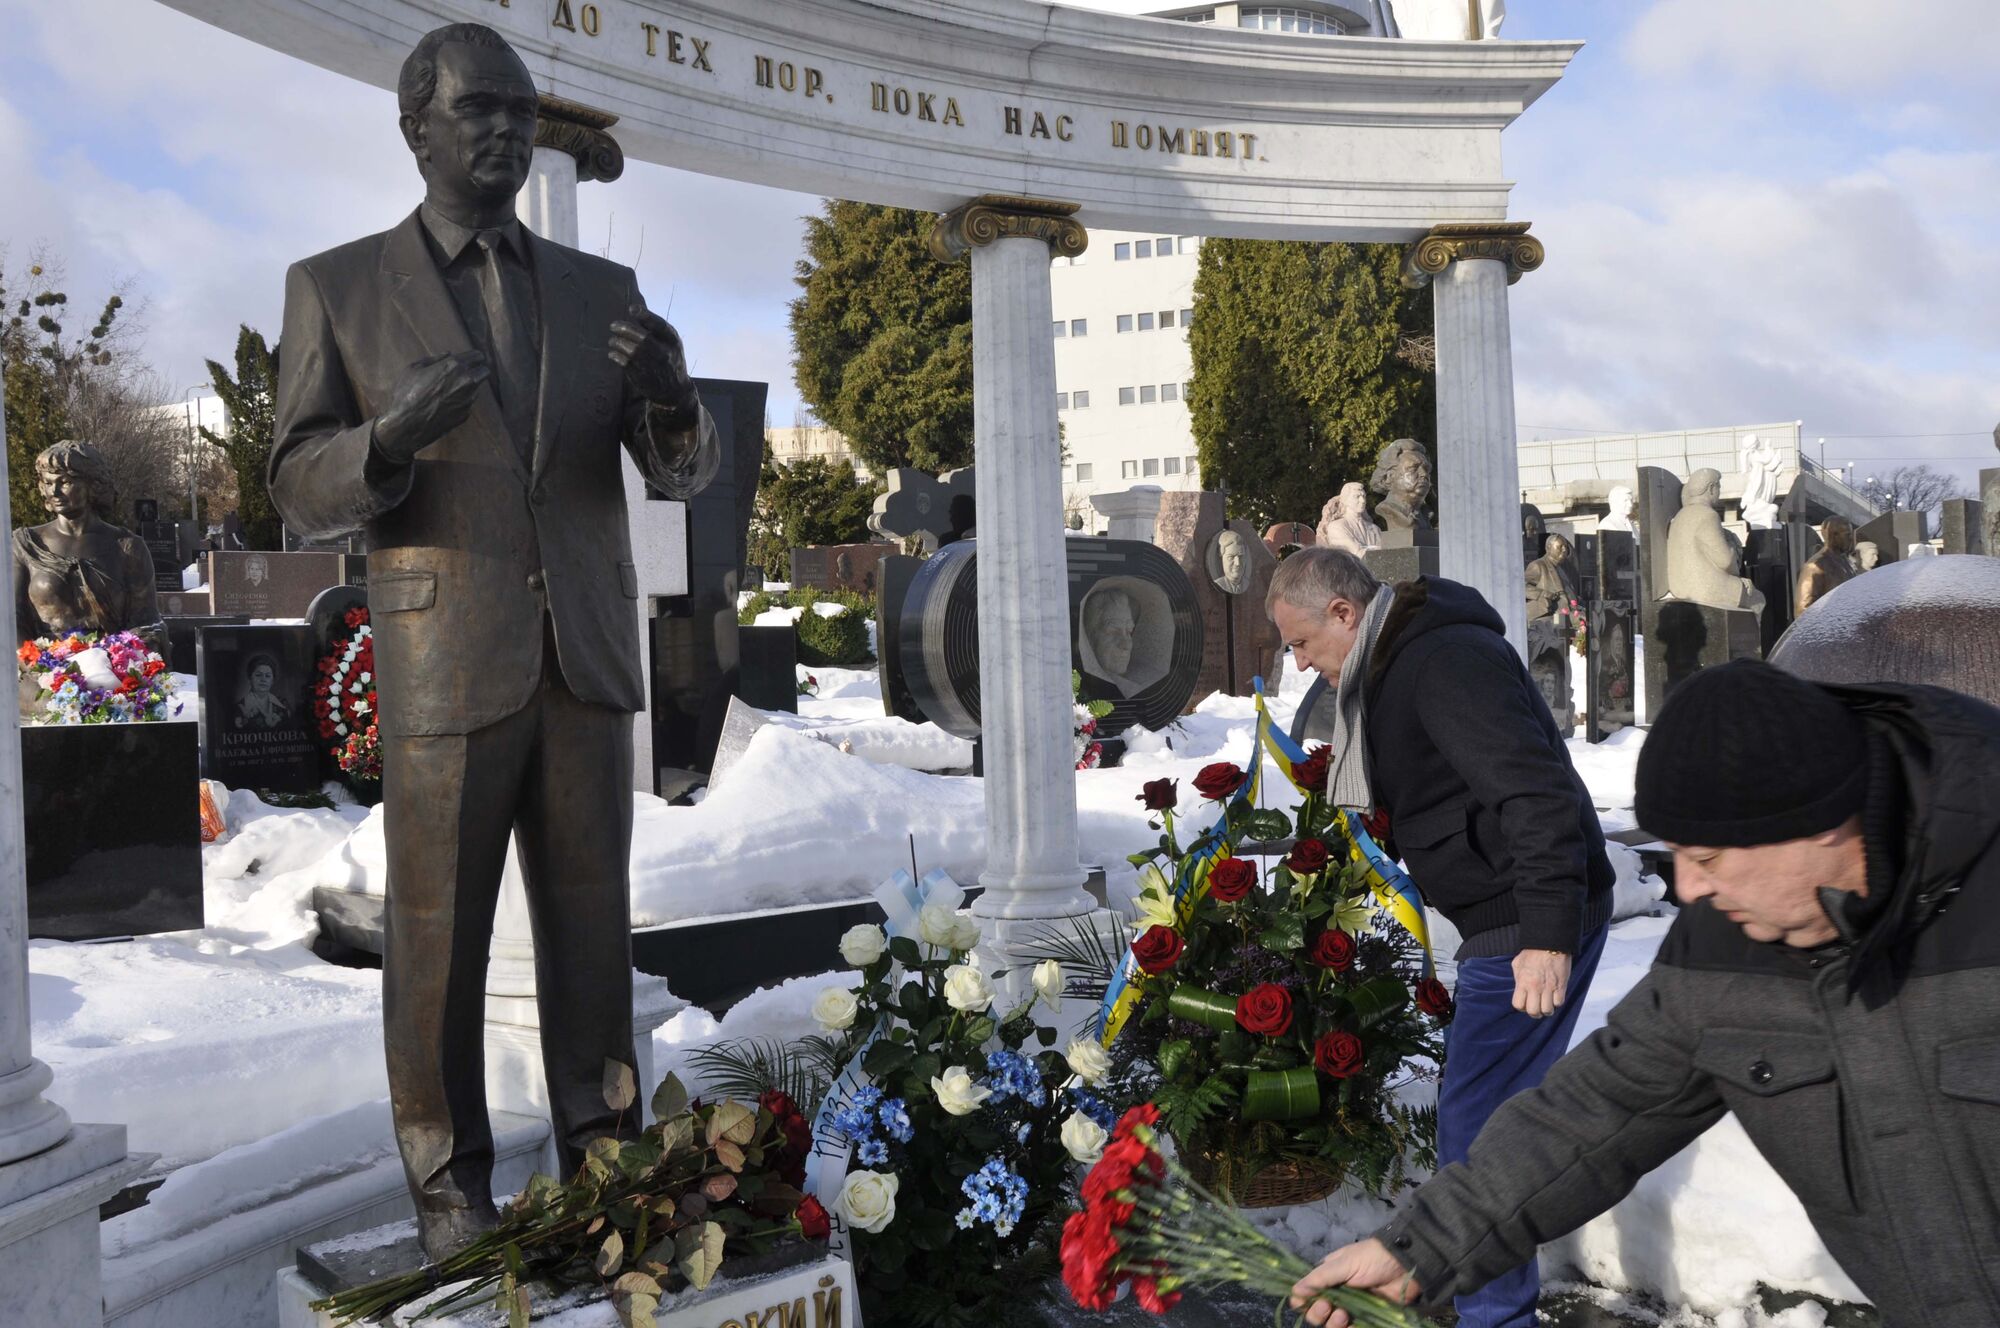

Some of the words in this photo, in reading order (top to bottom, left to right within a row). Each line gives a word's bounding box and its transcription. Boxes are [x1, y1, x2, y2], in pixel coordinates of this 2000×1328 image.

[552, 0, 601, 36] ДО
[641, 21, 713, 72] ТЕХ
[871, 81, 965, 127] ПОКА
[1004, 106, 1074, 142] НАС
[1111, 120, 1267, 162] ПОМНЯТ.
